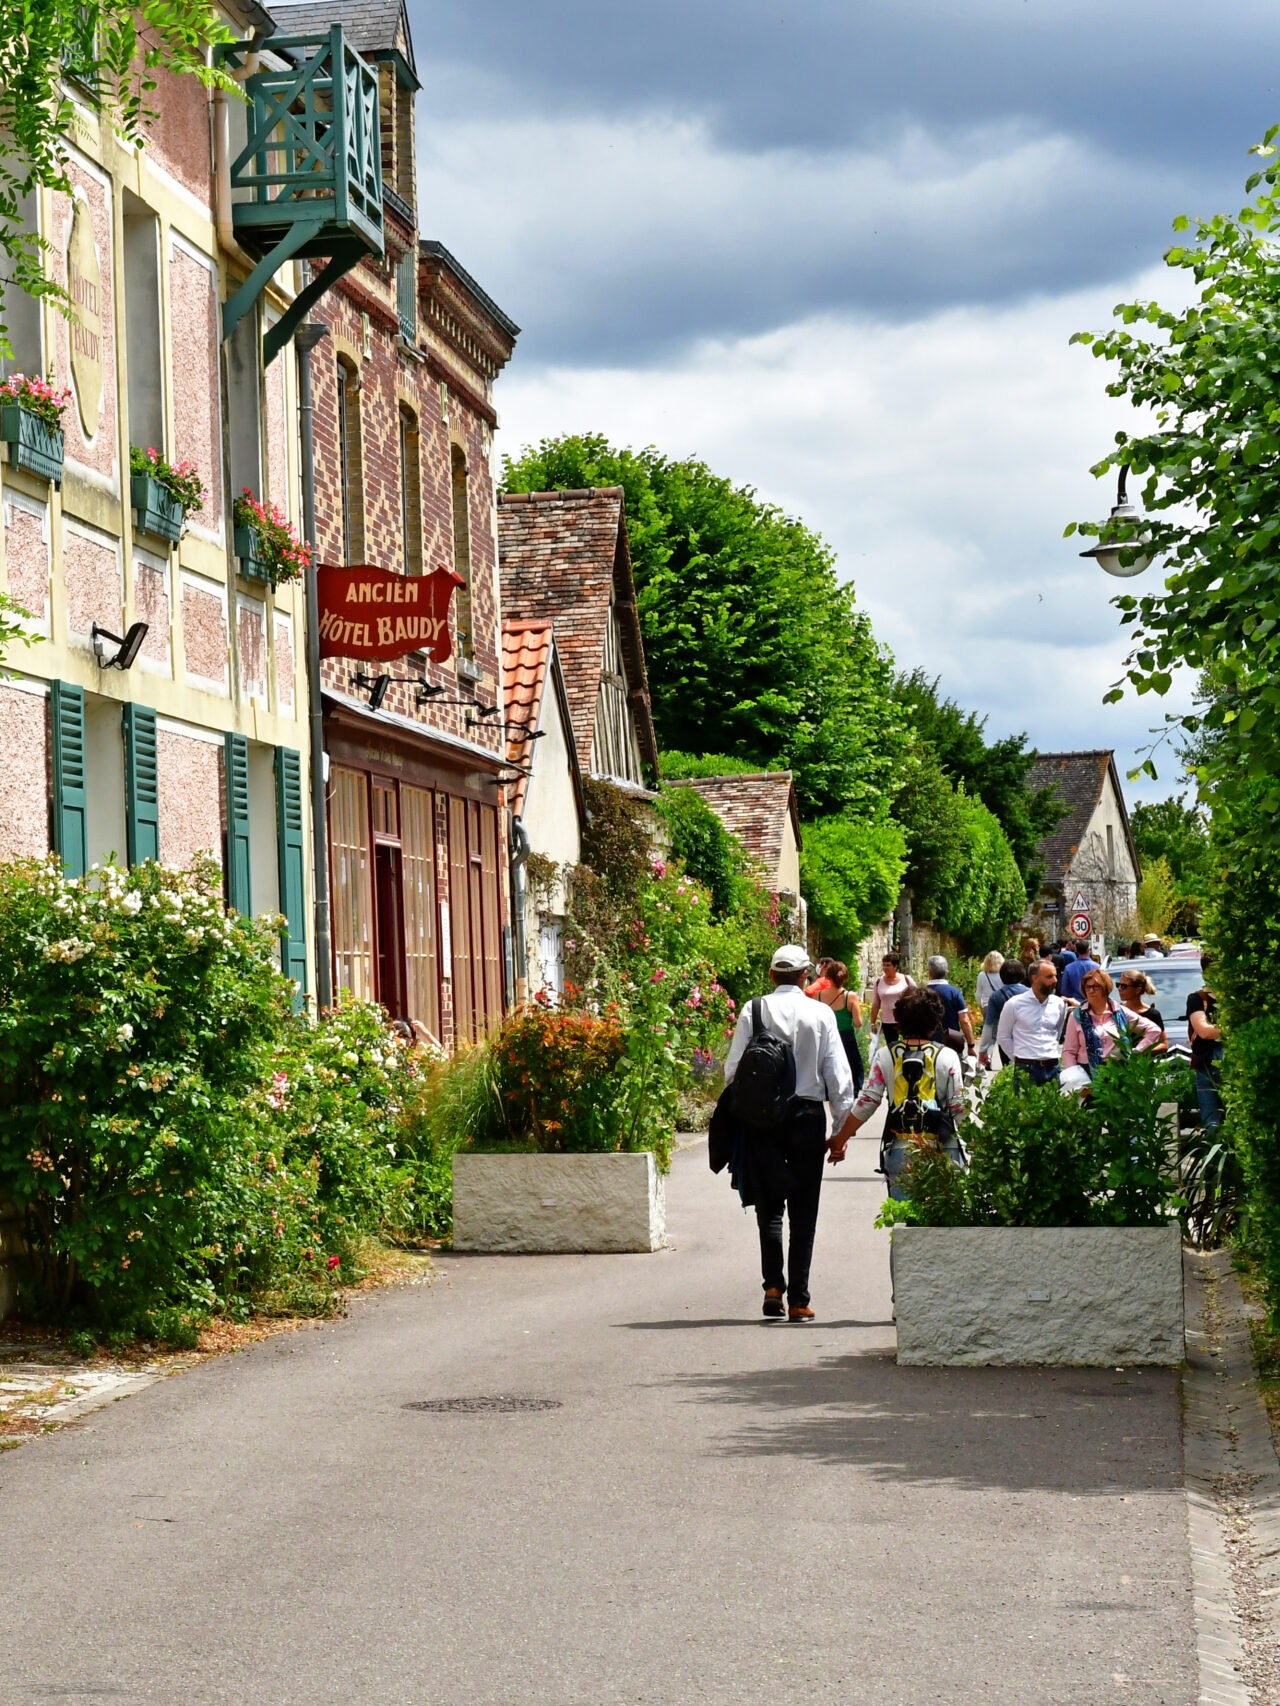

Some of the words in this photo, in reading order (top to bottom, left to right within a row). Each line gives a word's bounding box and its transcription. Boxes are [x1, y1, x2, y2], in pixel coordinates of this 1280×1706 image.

[74, 321, 100, 363] BAUDY
[345, 582, 419, 603] ANCIEN
[319, 608, 373, 647] HÔTEL
[376, 616, 446, 646] BAUDY
[1075, 920, 1087, 931] 30
